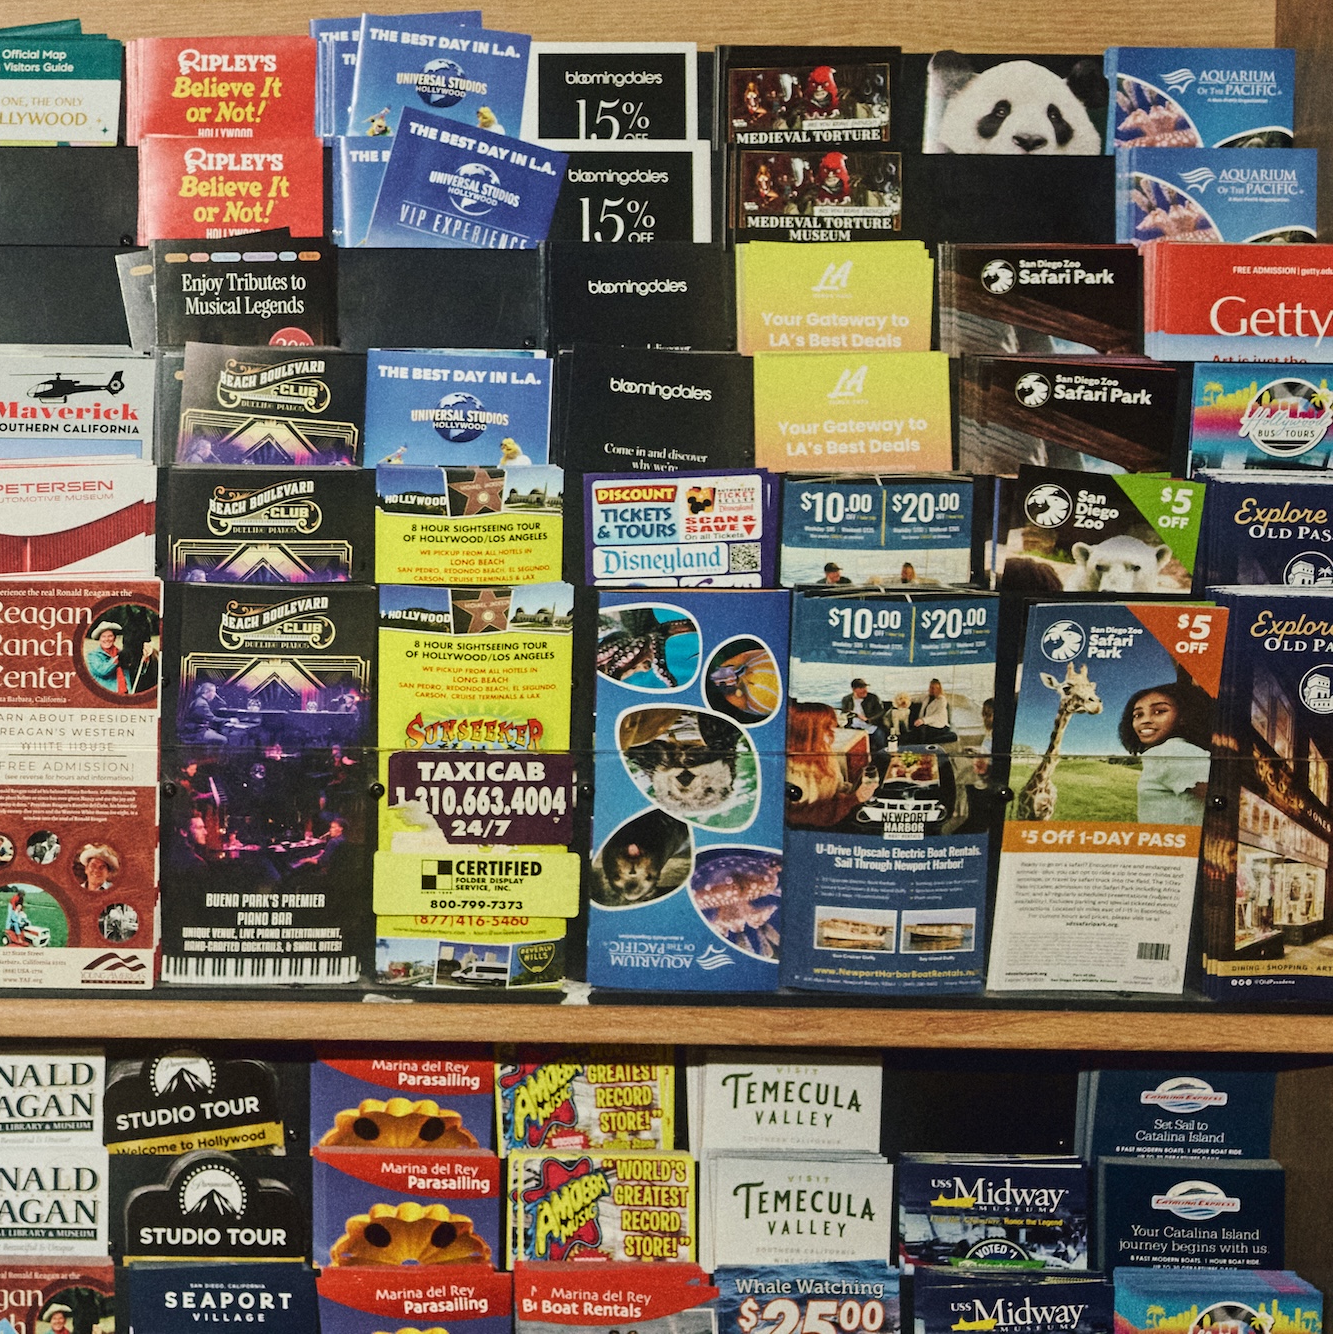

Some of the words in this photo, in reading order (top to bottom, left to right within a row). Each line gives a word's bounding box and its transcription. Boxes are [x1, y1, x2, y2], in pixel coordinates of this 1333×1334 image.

[178, 151, 284, 172] RIPLEY'S
[180, 177, 264, 199] Believe
[269, 177, 289, 198] It
[194, 206, 220, 221] or
[225, 201, 273, 223] Not!
[181, 274, 223, 295] Enjoy
[227, 273, 286, 291] Tributes
[290, 275, 306, 291] to
[186, 297, 239, 315] Musical
[244, 297, 304, 319] Legends
[1210, 296, 1333, 347] Getty
[64, 424, 139, 434] CALIFORNIA
[411, 524, 417, 532] 8
[421, 524, 450, 532] HOUR
[454, 524, 512, 532] SIGHTSEEING
[516, 523, 540, 531] TOUR
[418, 762, 545, 781] TAXICAB
[451, 820, 512, 837] 24/7
[1021, 830, 1038, 847] $5
[1041, 830, 1073, 848] Off
[1078, 831, 1132, 848] 1-DAY
[1138, 832, 1186, 848] PASS
[456, 861, 542, 876] CERTIFIED
[430, 901, 523, 909] 800-799-7373
[721, 1073, 862, 1112] TEMECULA
[754, 1111, 834, 1128] VALLEY
[139, 1226, 222, 1245] STUDIO
[228, 1227, 287, 1246] TOUR
[736, 1279, 791, 1296] Whale
[796, 1279, 884, 1298] Watching
[165, 1291, 292, 1311] SEAPORT
